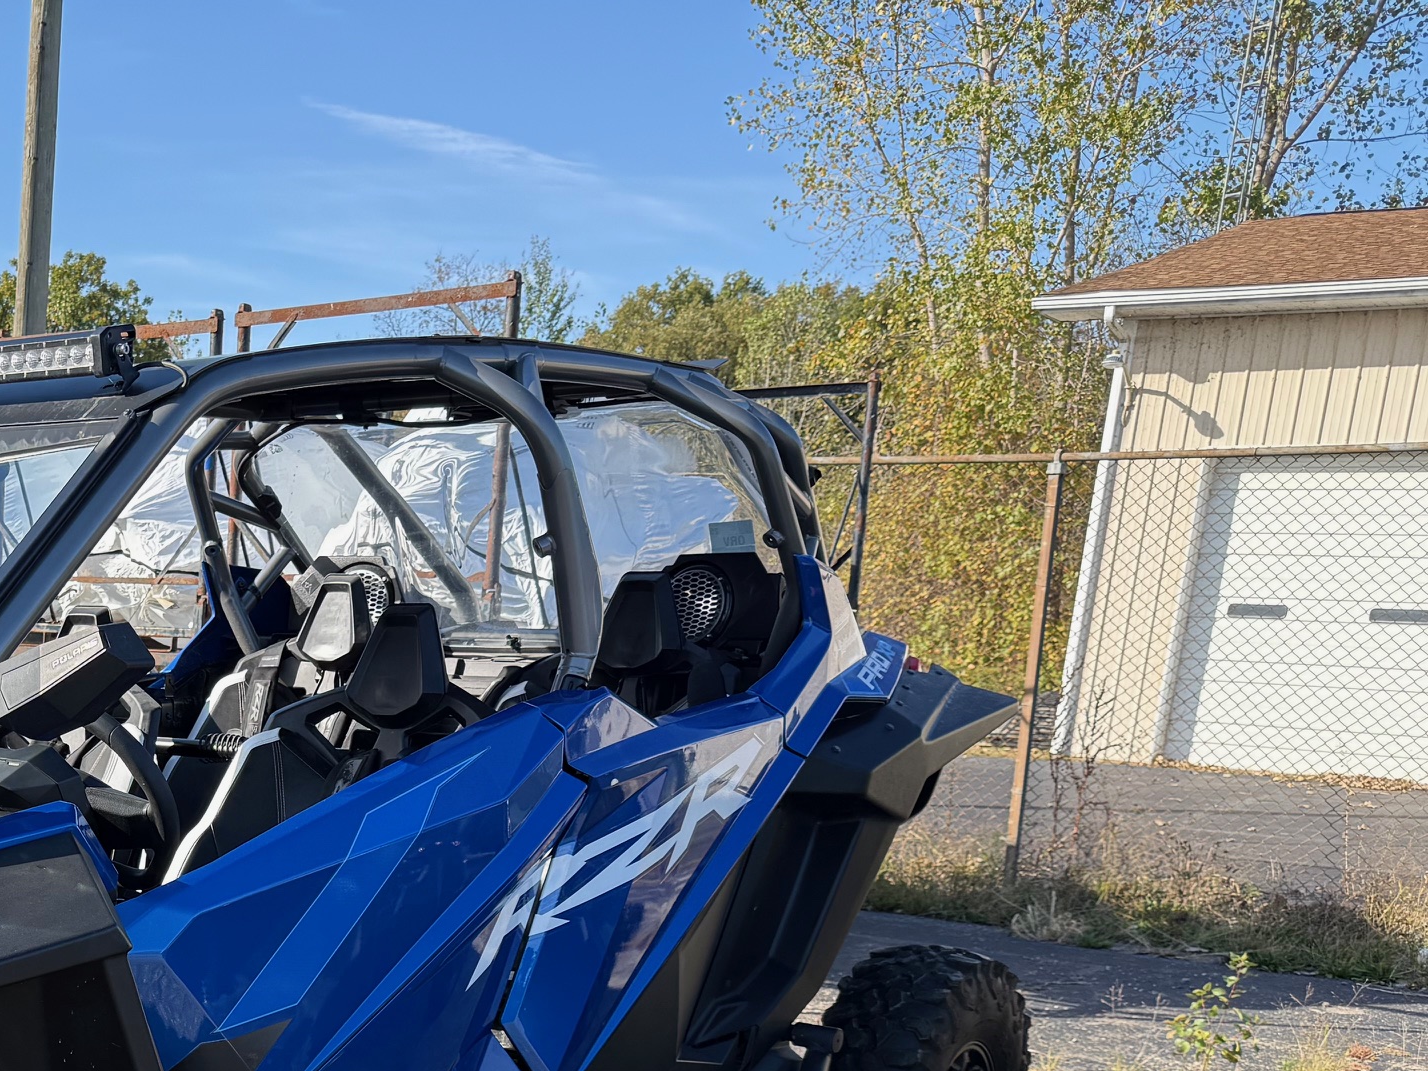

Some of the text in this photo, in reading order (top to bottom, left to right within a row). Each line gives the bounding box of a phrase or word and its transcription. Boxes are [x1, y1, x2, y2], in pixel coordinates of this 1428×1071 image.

[52, 637, 99, 669] POLARIS
[857, 651, 892, 690] PRO
[465, 733, 765, 992] RZR
